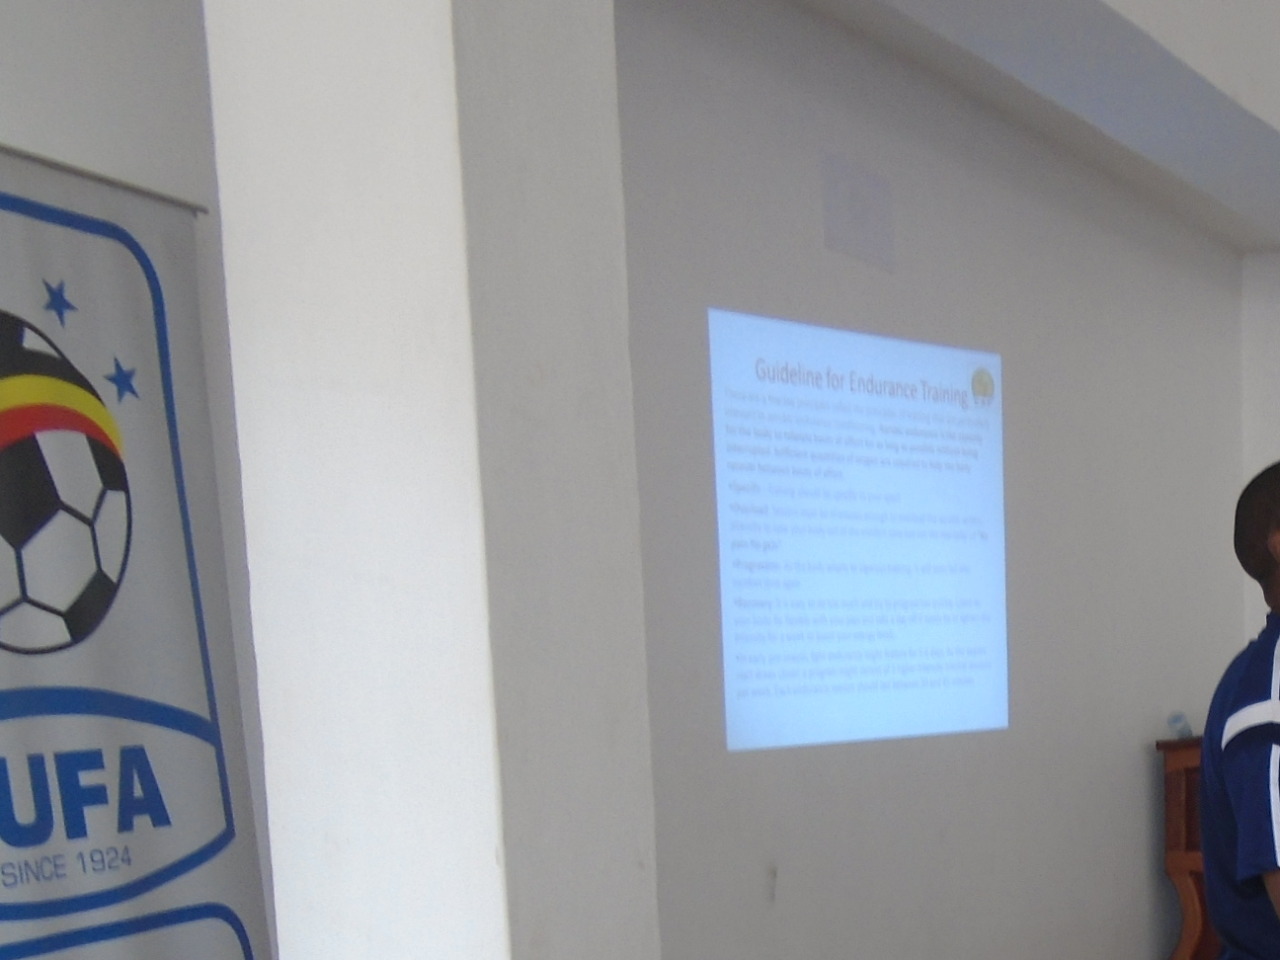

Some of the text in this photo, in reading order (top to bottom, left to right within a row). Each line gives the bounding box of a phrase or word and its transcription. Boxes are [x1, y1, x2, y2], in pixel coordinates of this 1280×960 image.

[754, 357, 969, 409] Guideline for Endurance Training
[1, 845, 133, 889] SINCE 1924
